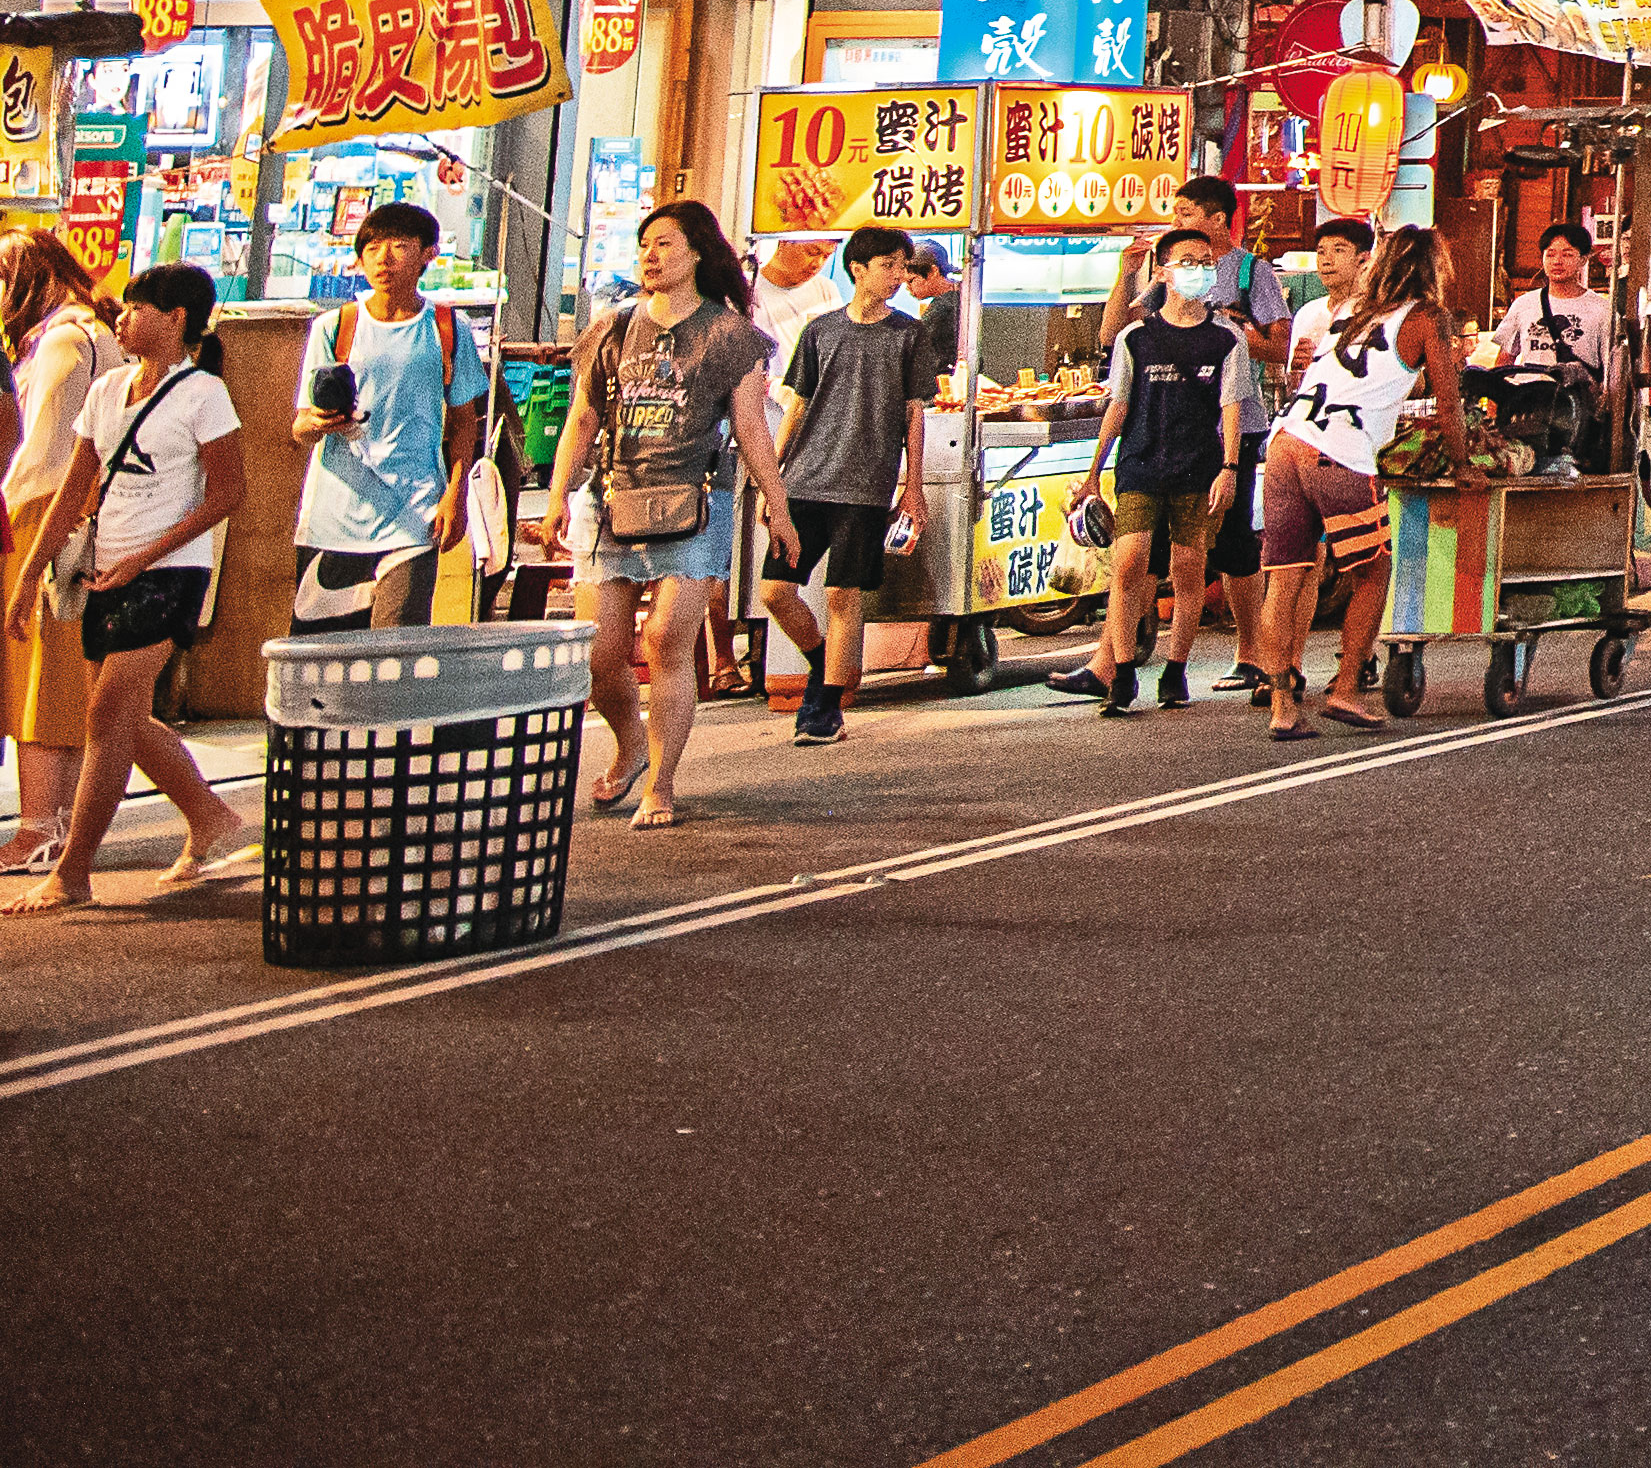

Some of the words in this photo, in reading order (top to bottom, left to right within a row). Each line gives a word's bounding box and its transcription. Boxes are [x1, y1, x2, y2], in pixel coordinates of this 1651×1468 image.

[875, 99, 968, 155] 蜜汁
[873, 165, 966, 219] 碳烤
[989, 485, 1044, 543] 蜜汁
